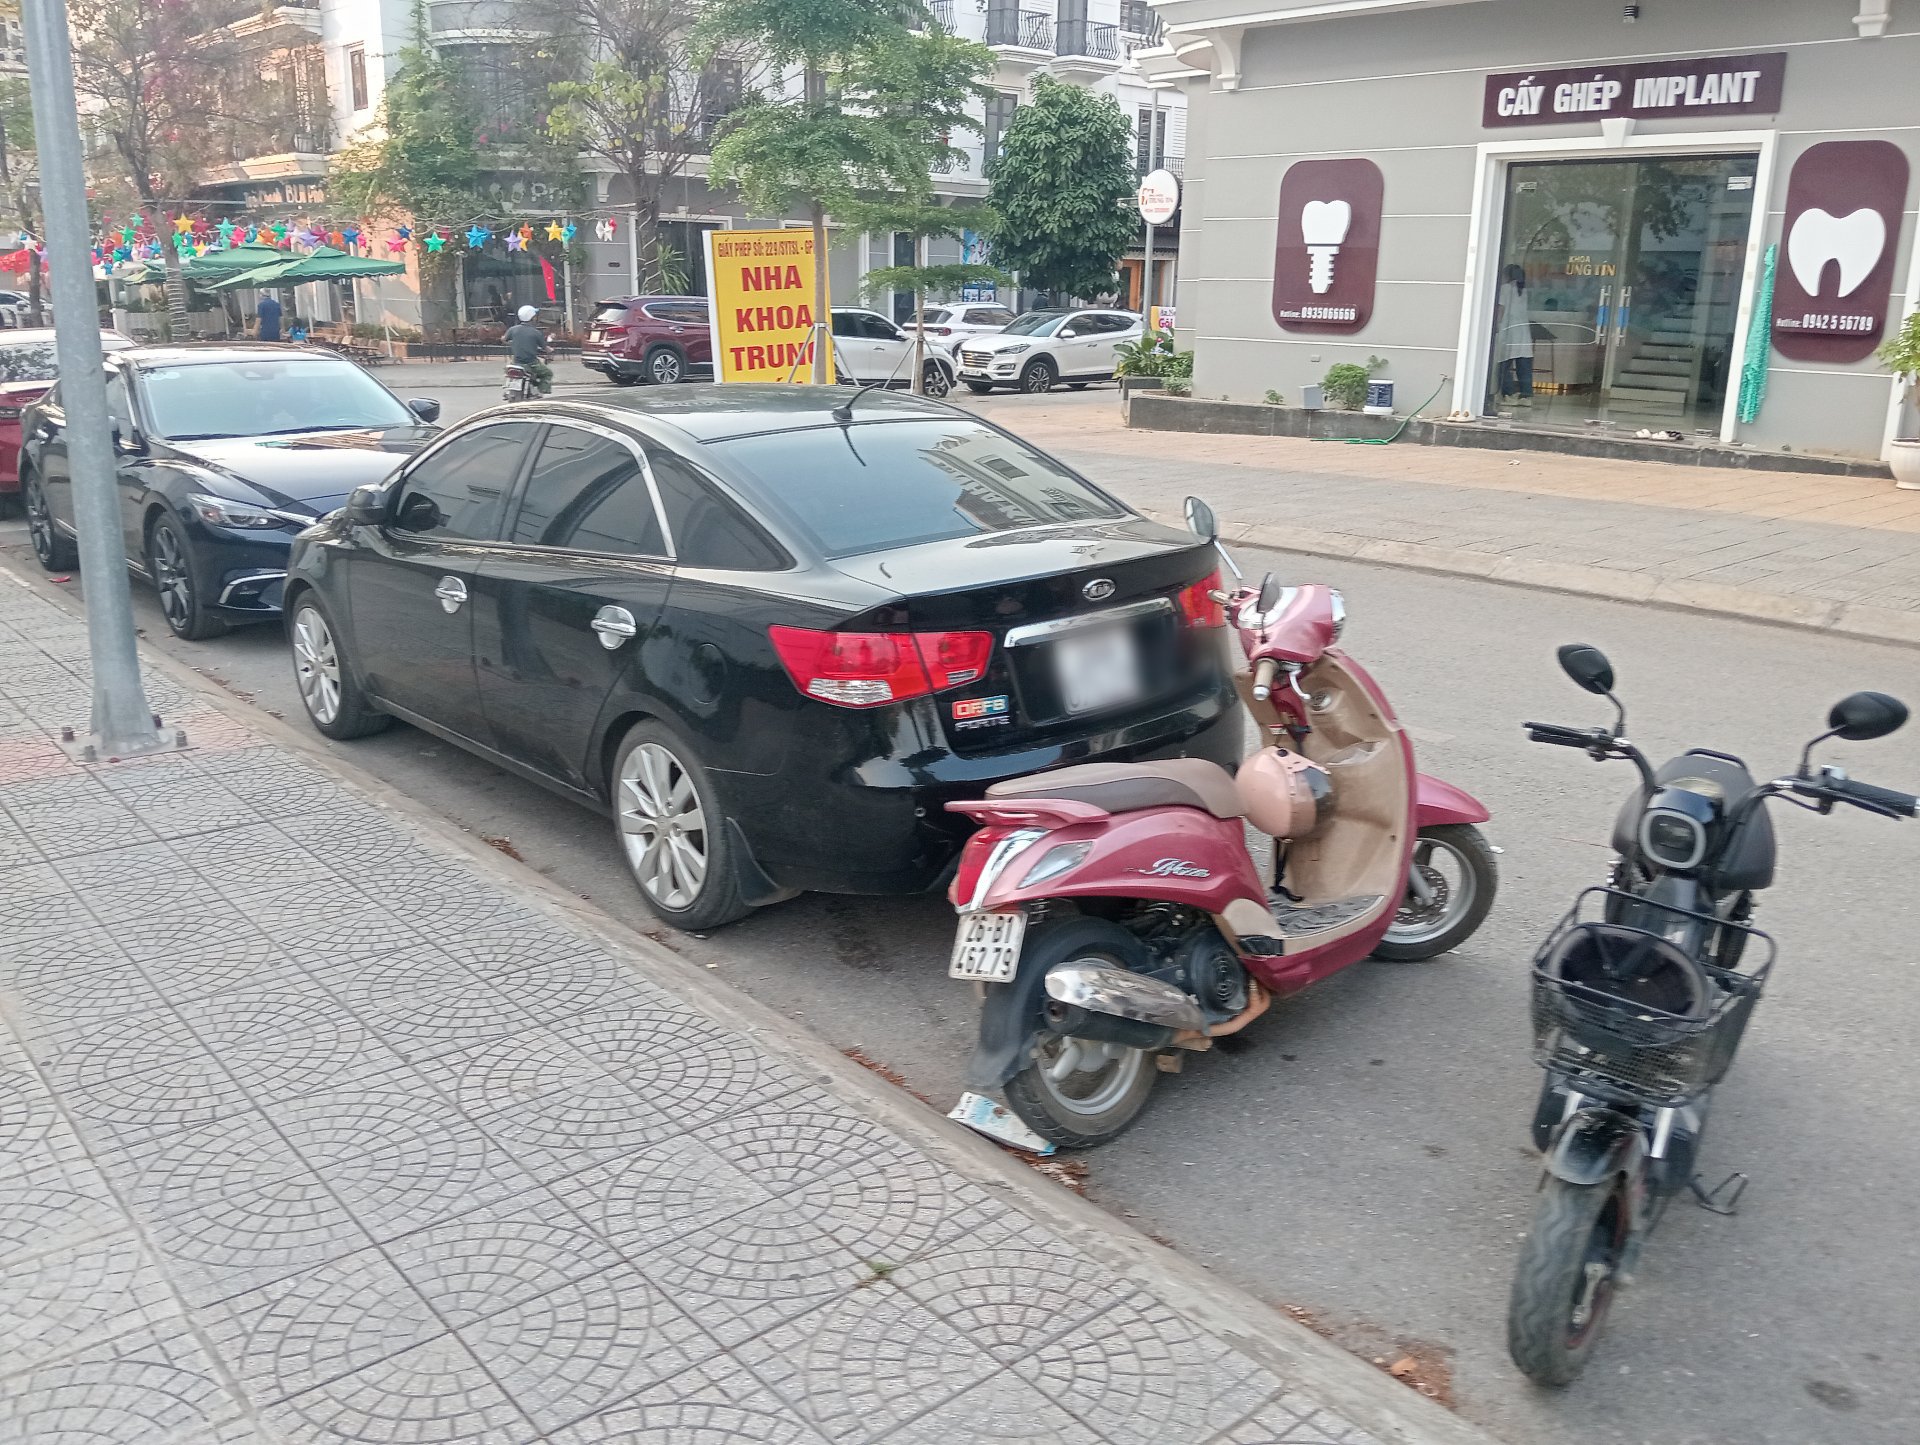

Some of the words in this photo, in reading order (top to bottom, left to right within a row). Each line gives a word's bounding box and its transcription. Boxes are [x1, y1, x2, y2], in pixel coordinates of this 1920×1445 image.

[1497, 75, 1545, 117] CẤY
[1553, 74, 1622, 113] GHÉP
[1632, 71, 1762, 108] IMPLANT
[718, 238, 733, 257] GIẤY
[735, 239, 751, 257] PHÉP
[741, 265, 803, 291] NHA
[736, 305, 814, 333] KHOA
[966, 915, 1013, 943] 26-B1
